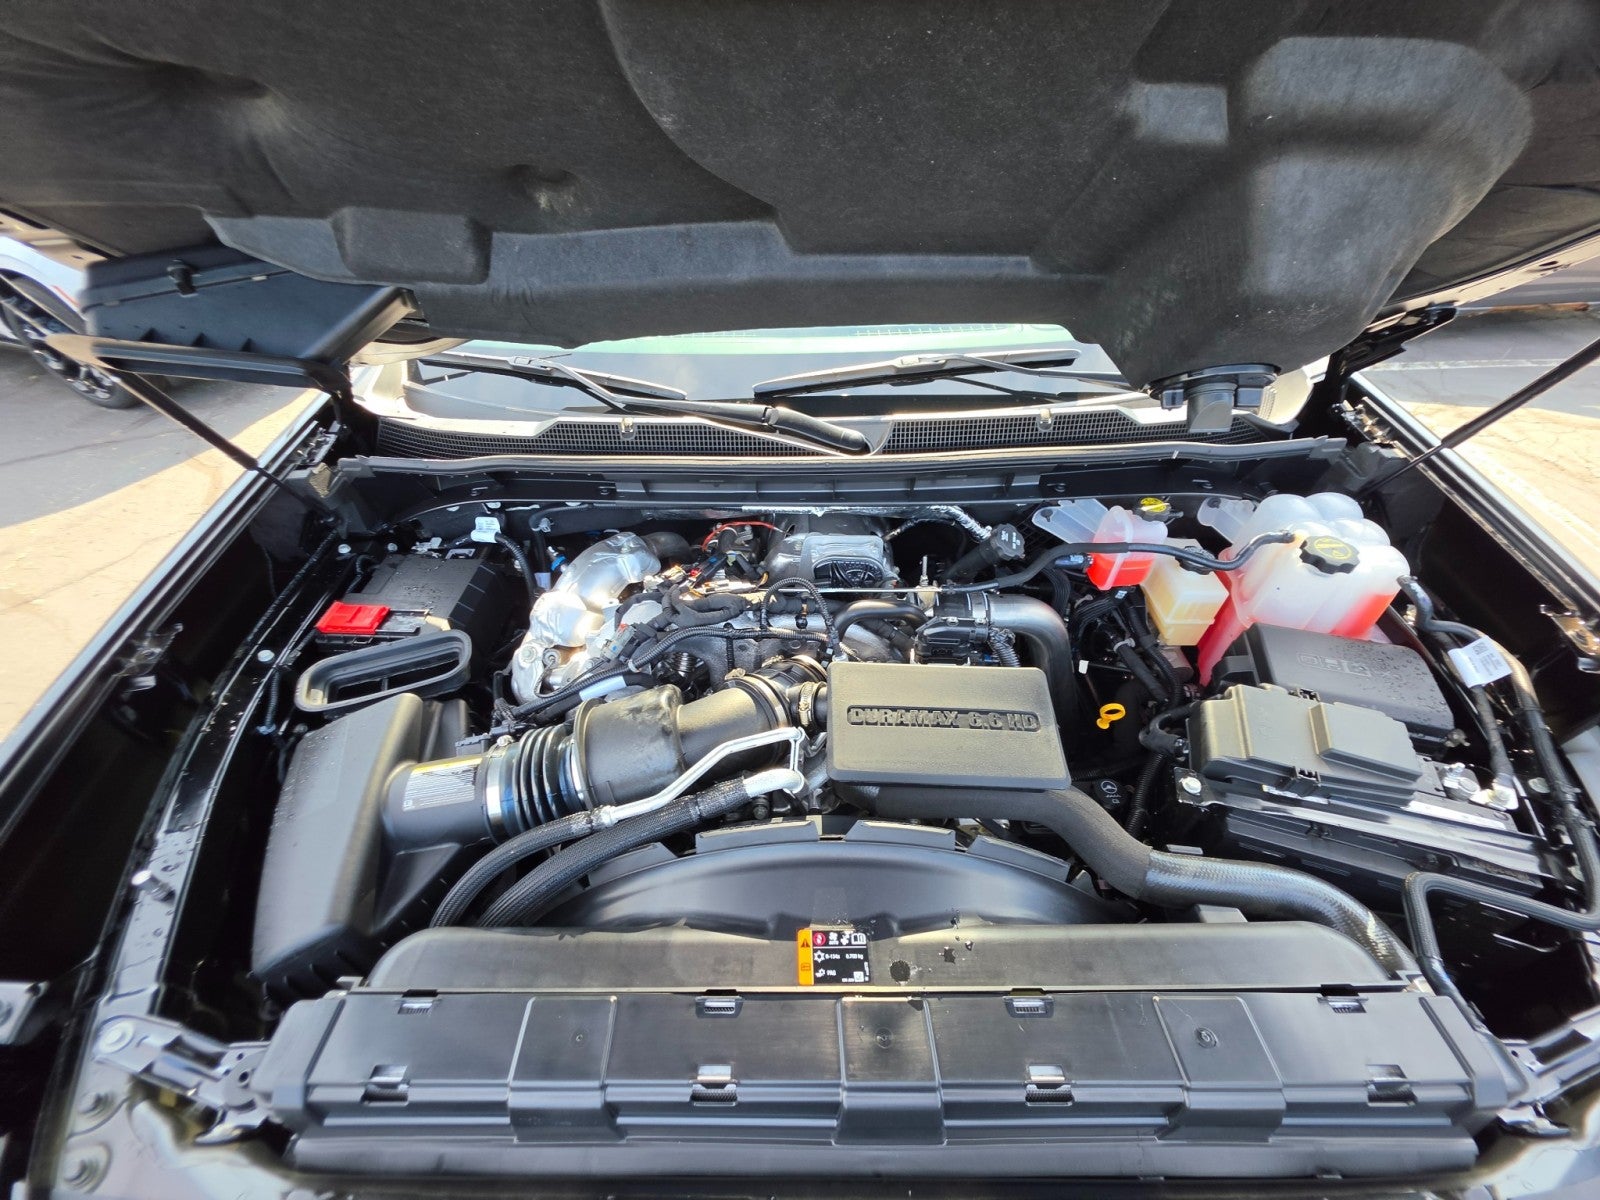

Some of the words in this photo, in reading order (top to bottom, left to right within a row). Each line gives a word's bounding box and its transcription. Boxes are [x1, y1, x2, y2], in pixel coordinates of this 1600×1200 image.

[850, 708, 959, 727] DURAMAX
[968, 712, 1003, 730] 6.6
[1007, 713, 1038, 731] HD
